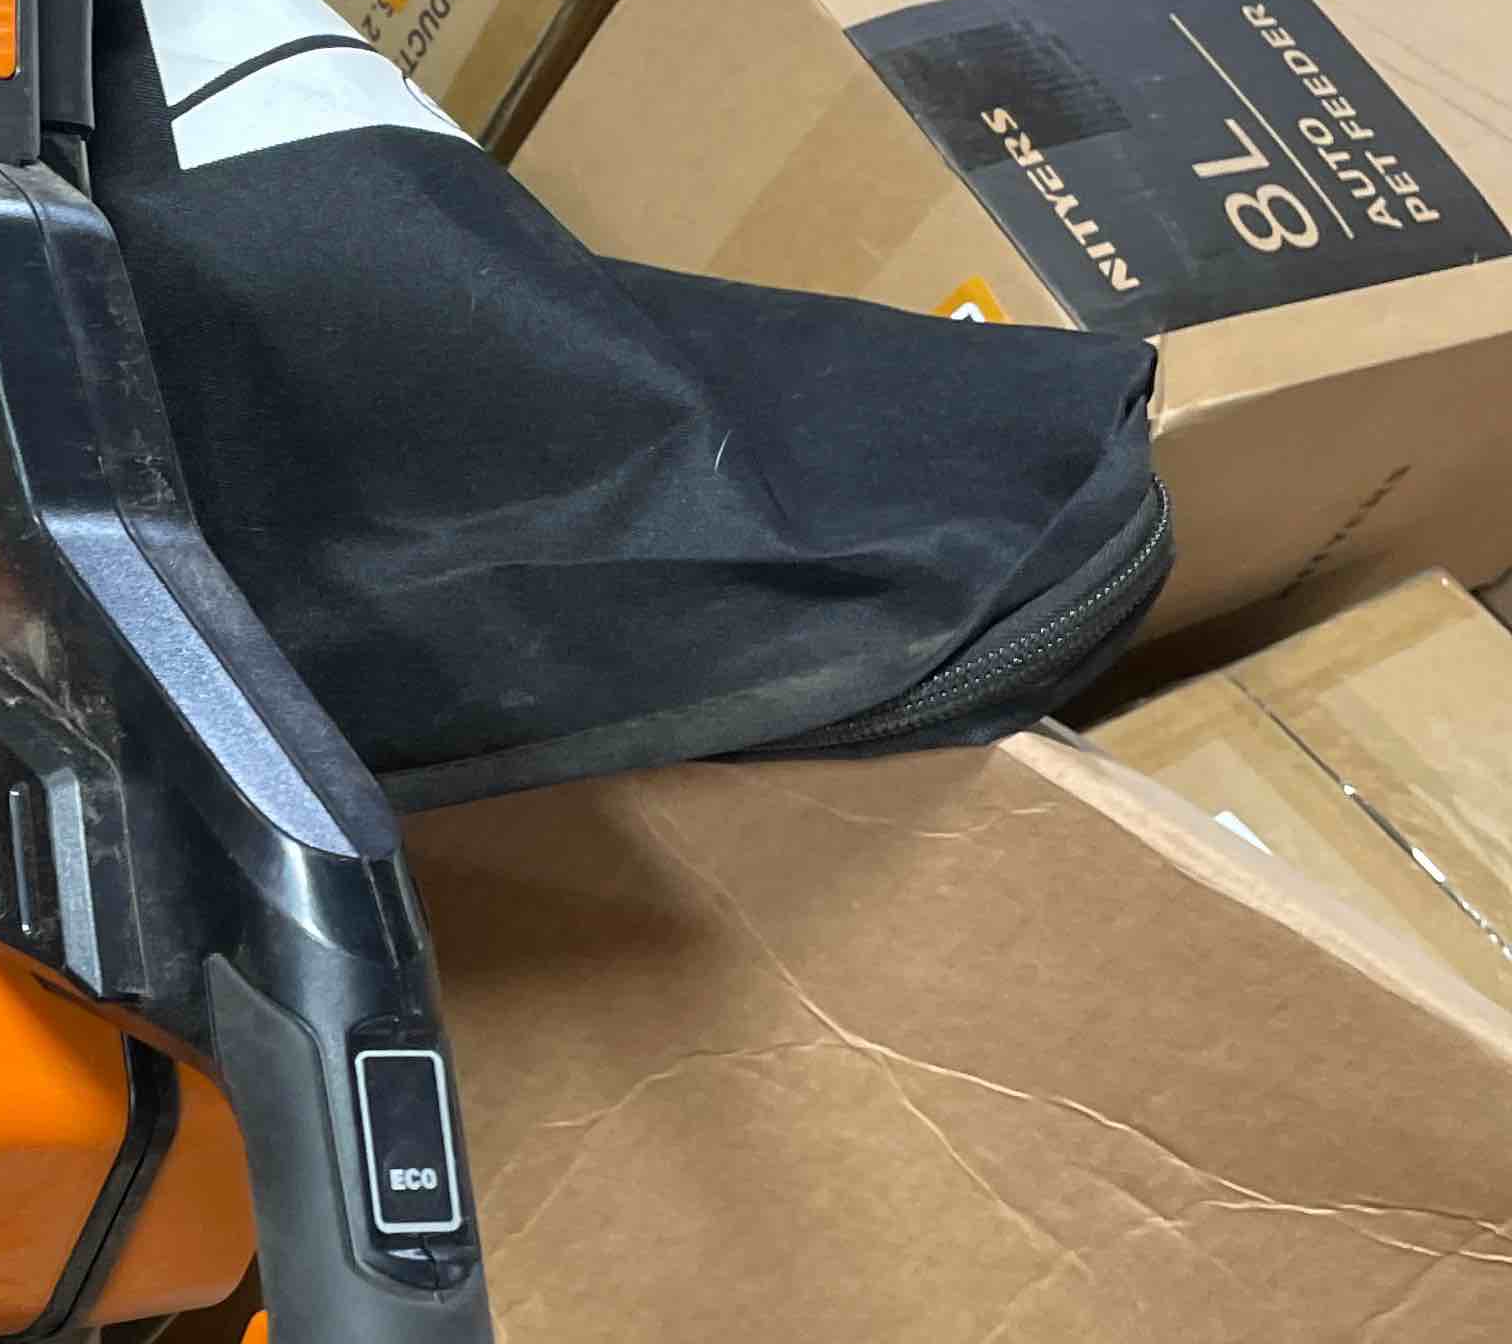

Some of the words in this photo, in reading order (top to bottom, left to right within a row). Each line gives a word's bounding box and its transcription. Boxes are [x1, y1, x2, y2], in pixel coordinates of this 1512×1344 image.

[1241, 2, 1376, 140] FEEDER
[981, 106, 1141, 292] NITYERS
[1191, 117, 1321, 254] 8L
[1298, 116, 1403, 229] AUTO
[1364, 150, 1441, 224] PET
[390, 1167, 438, 1190] ECO
